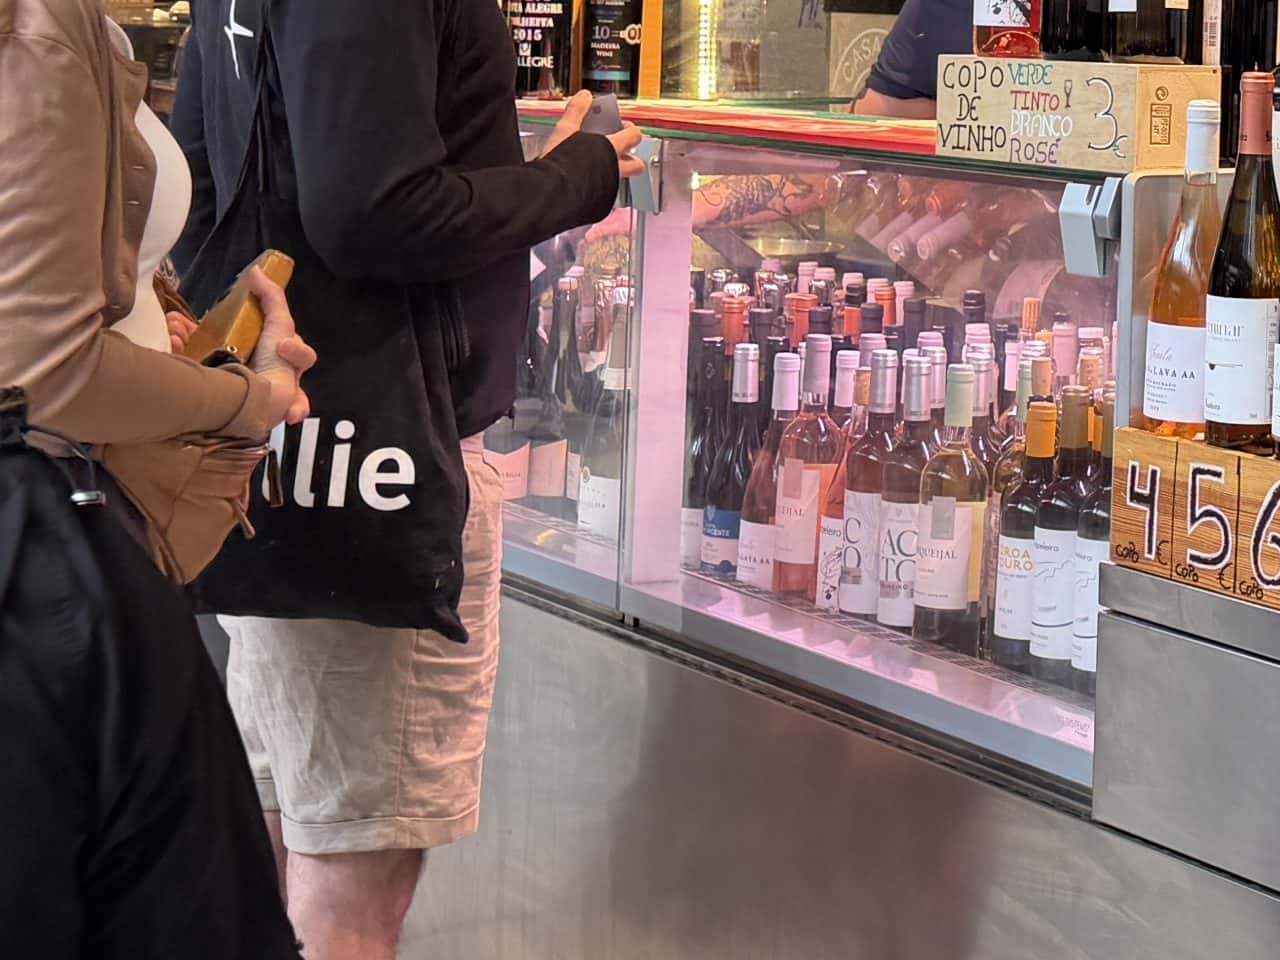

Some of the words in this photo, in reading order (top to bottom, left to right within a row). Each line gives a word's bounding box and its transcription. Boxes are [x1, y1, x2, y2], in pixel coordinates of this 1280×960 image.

[943, 60, 1004, 93] COPO
[1007, 63, 1055, 86] VERDE
[956, 93, 982, 122] DE
[1010, 90, 1060, 112] TINTO
[938, 123, 1007, 152] VINHO
[1009, 110, 1073, 138] BRANCO
[1009, 138, 1061, 165] ROSÉ
[1153, 367, 1177, 378] LAVA
[1126, 458, 1161, 561] 4
[1186, 462, 1232, 571] 5
